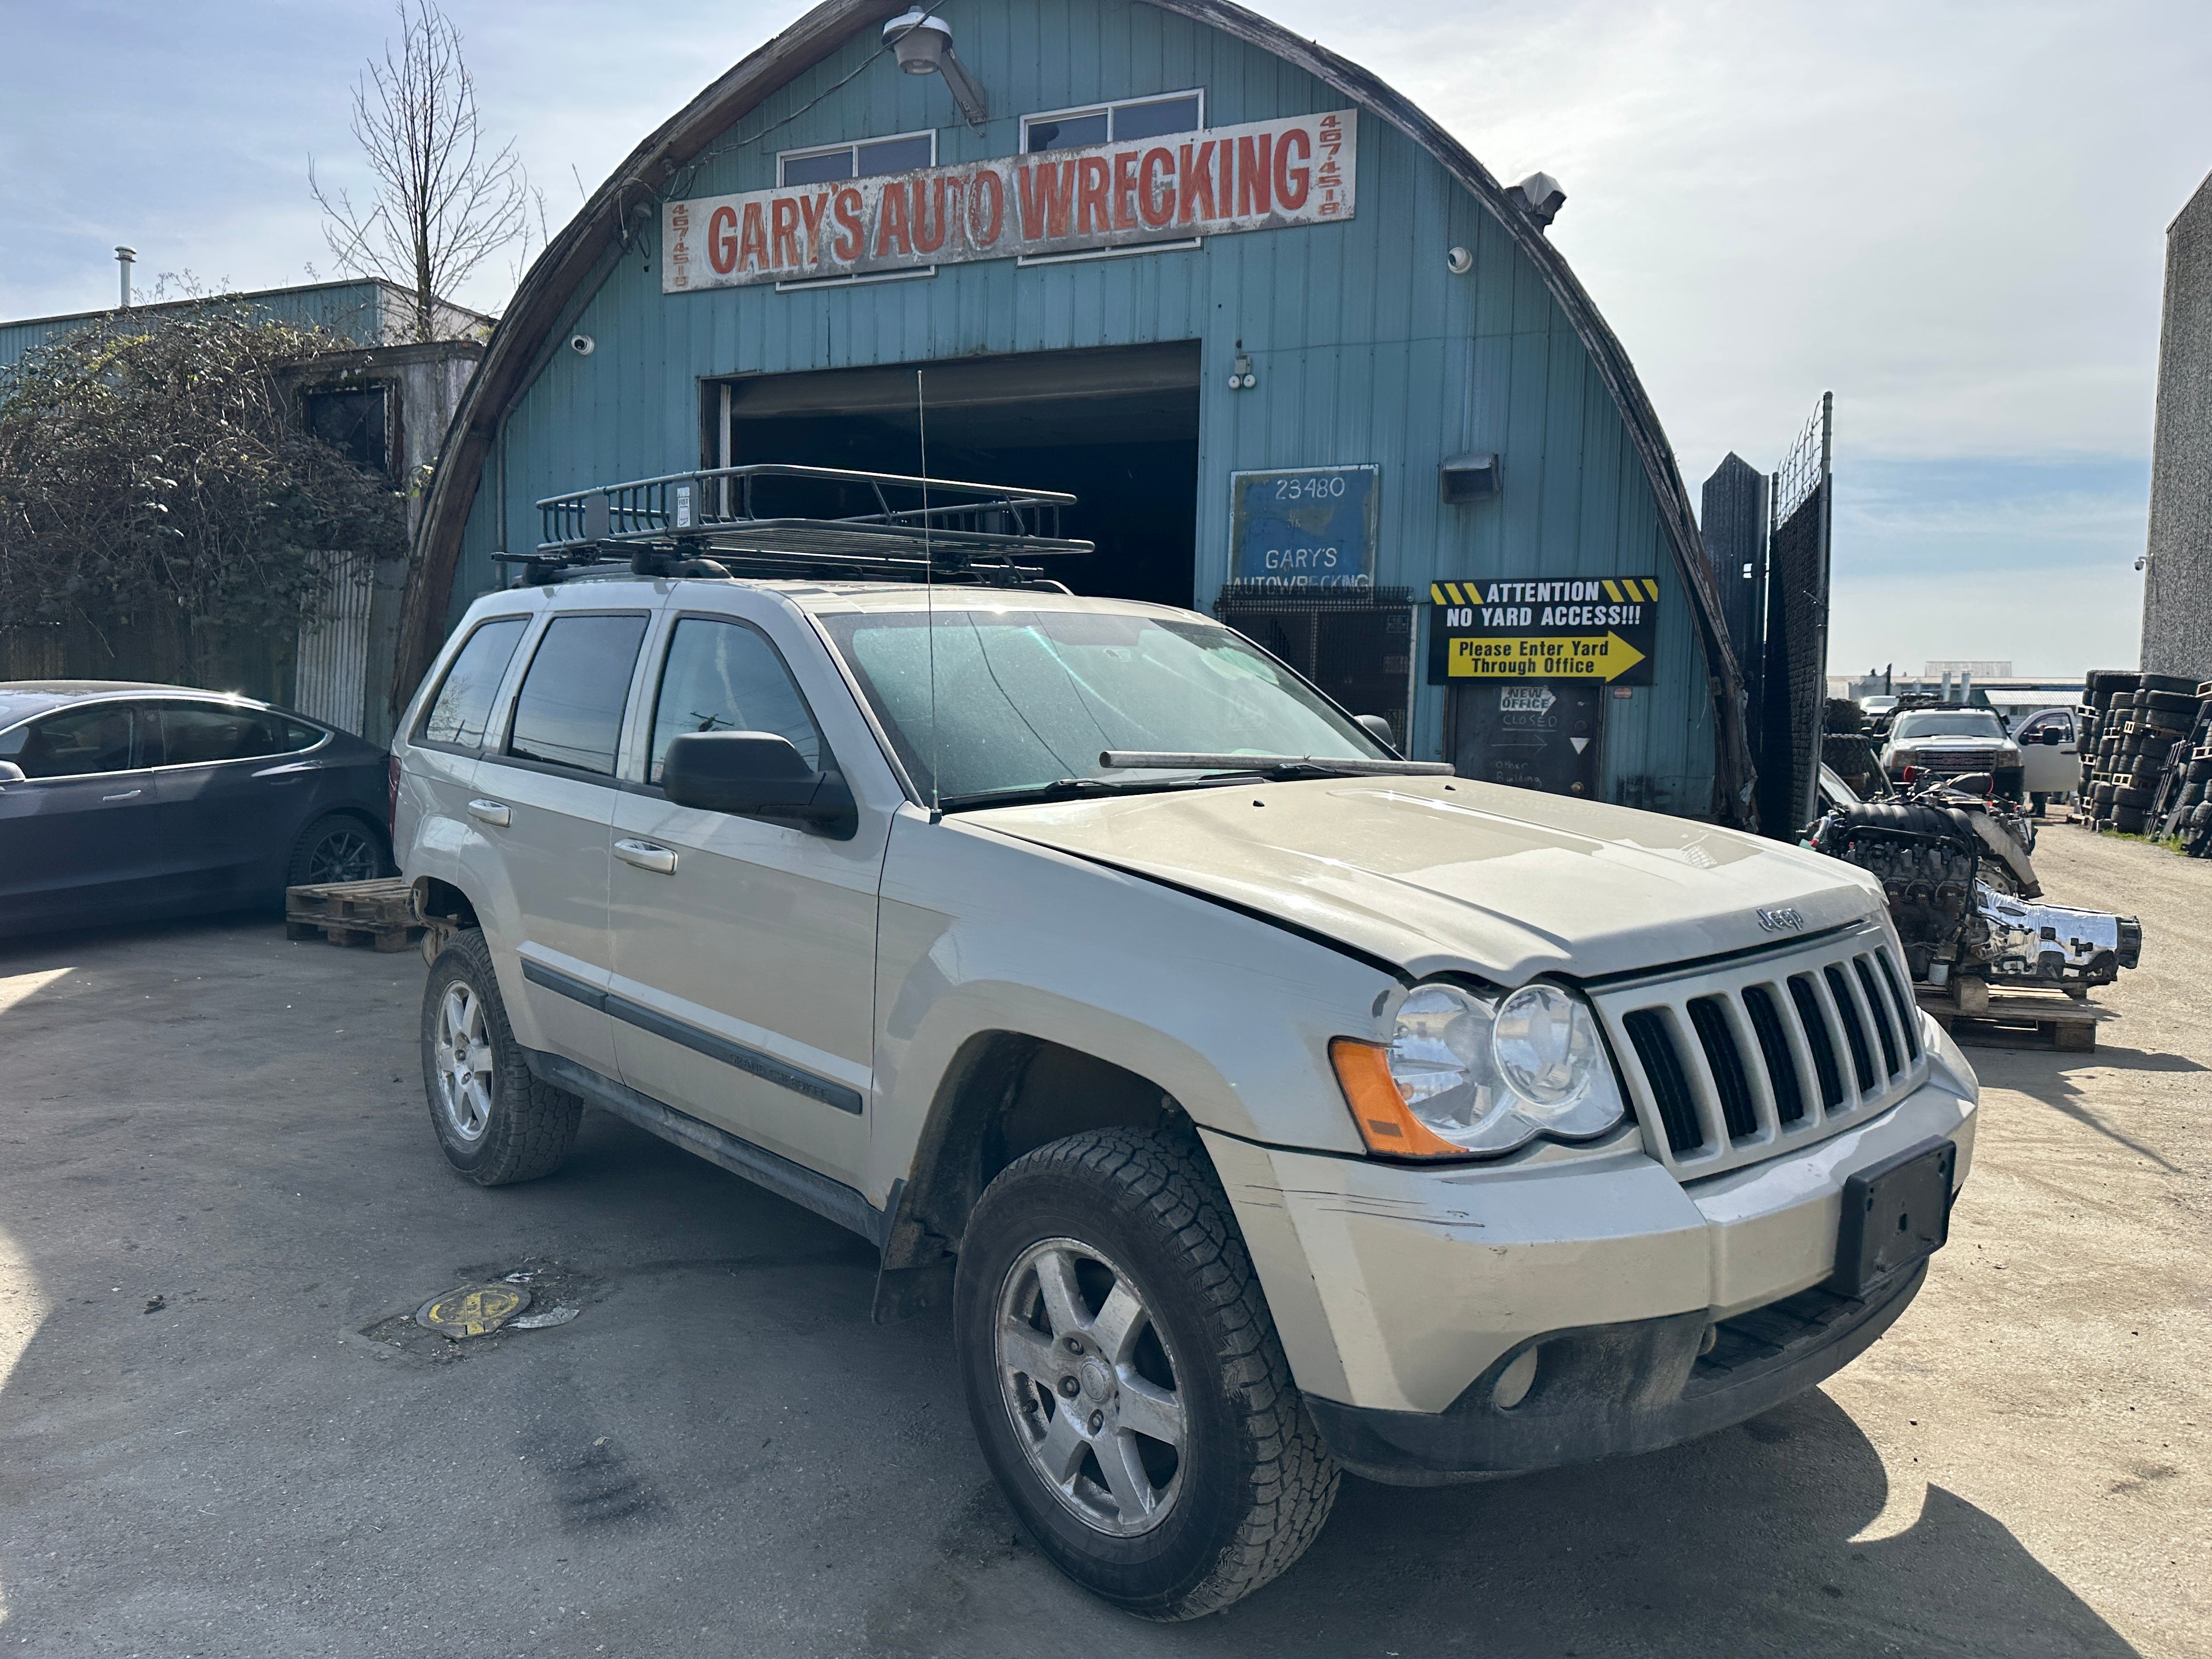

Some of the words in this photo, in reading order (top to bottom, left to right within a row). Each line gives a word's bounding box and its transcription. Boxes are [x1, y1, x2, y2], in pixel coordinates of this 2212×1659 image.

[707, 183, 863, 275] GARY'S
[875, 170, 1003, 257] AUTO
[1018, 128, 1311, 240] WRECKING
[1275, 476, 1346, 500] 23480
[1265, 547, 1338, 569] GARY'S
[1486, 581, 1599, 603] ATTENTION
[1446, 608, 1472, 627] NO
[1482, 607, 1532, 627] YARD
[1540, 605, 1641, 626] ACCESS!!!
[1459, 642, 1512, 657] Please
[1519, 641, 1564, 656] Enter
[1571, 640, 1609, 656] Yard
[1472, 657, 1541, 675] Through
[1544, 657, 1594, 673] Office
[1502, 698, 1550, 709] OFFICE
[1507, 688, 1543, 698] NEW
[1503, 715, 1557, 728] CLOSED
[1756, 908, 1804, 931] Jeep
